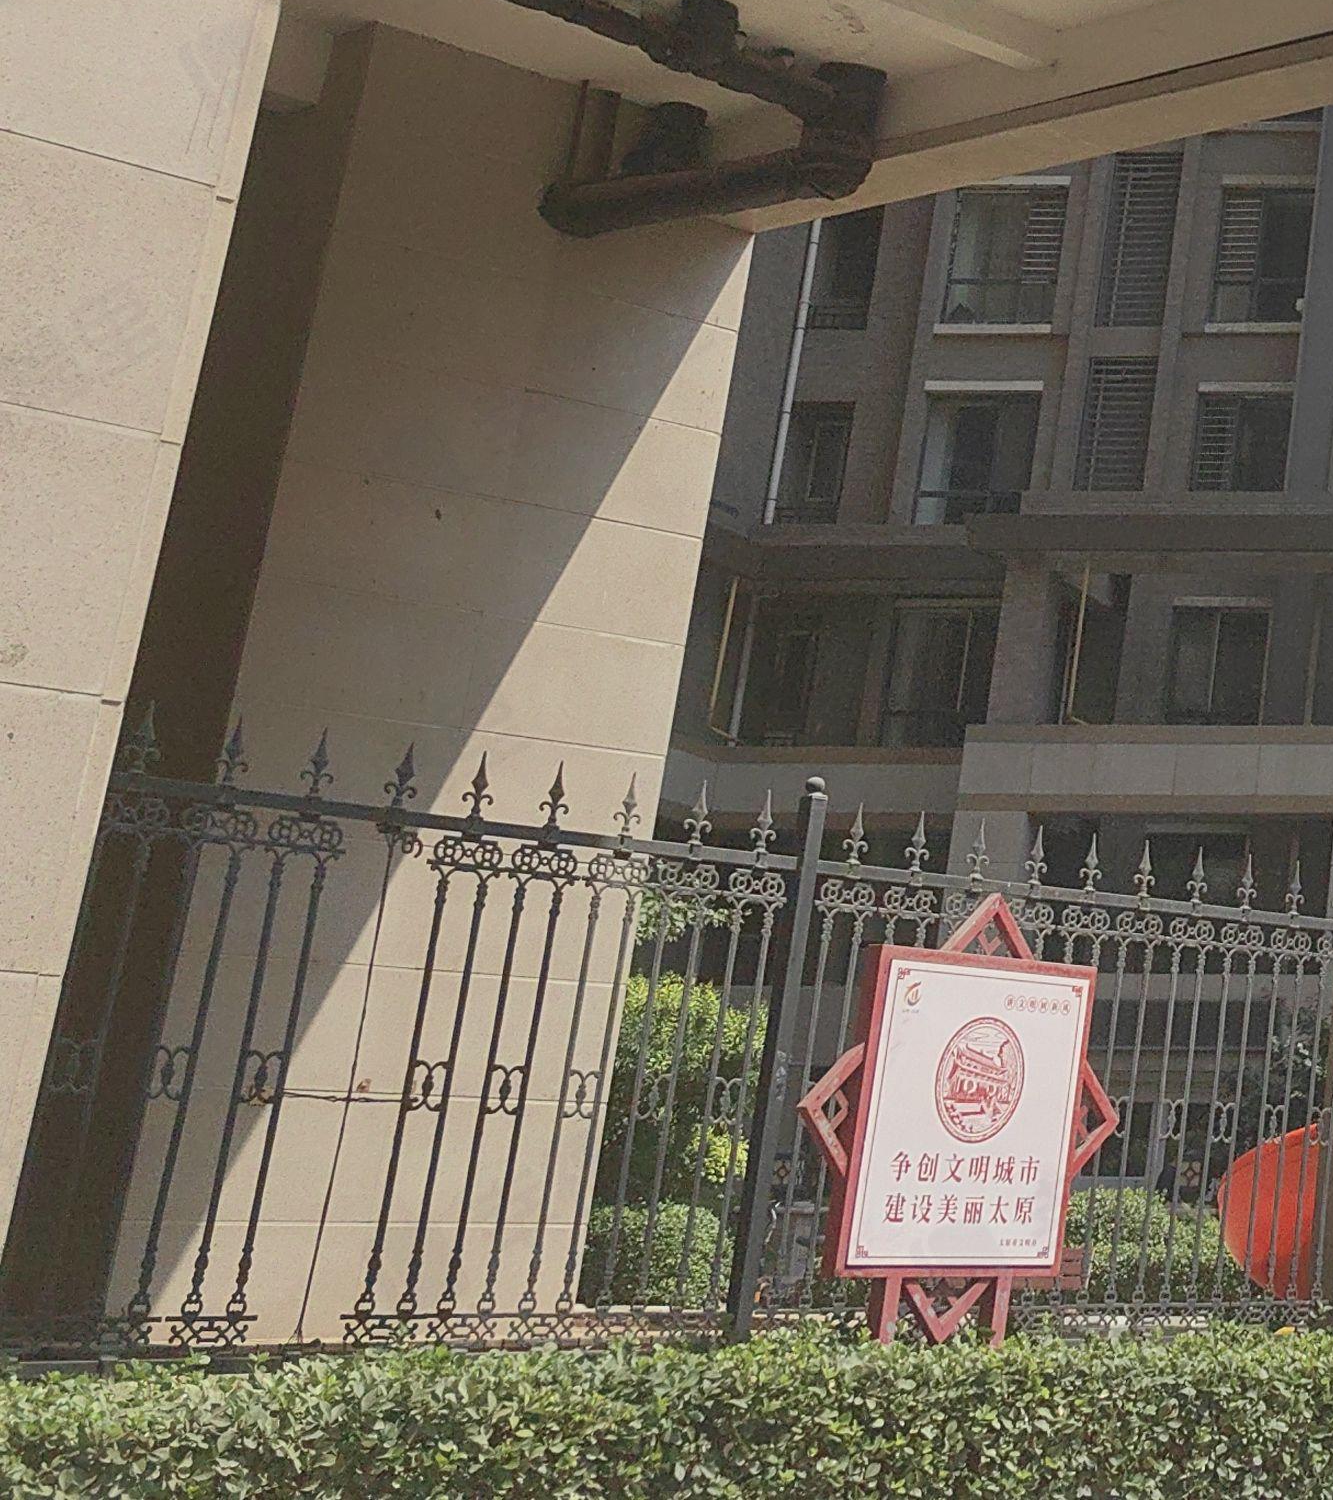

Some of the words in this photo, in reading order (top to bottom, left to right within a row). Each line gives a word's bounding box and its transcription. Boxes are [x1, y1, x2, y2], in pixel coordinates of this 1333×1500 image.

[890, 1151, 1040, 1185] 争创文明城市
[883, 1192, 1035, 1225] 建设美丽太原
